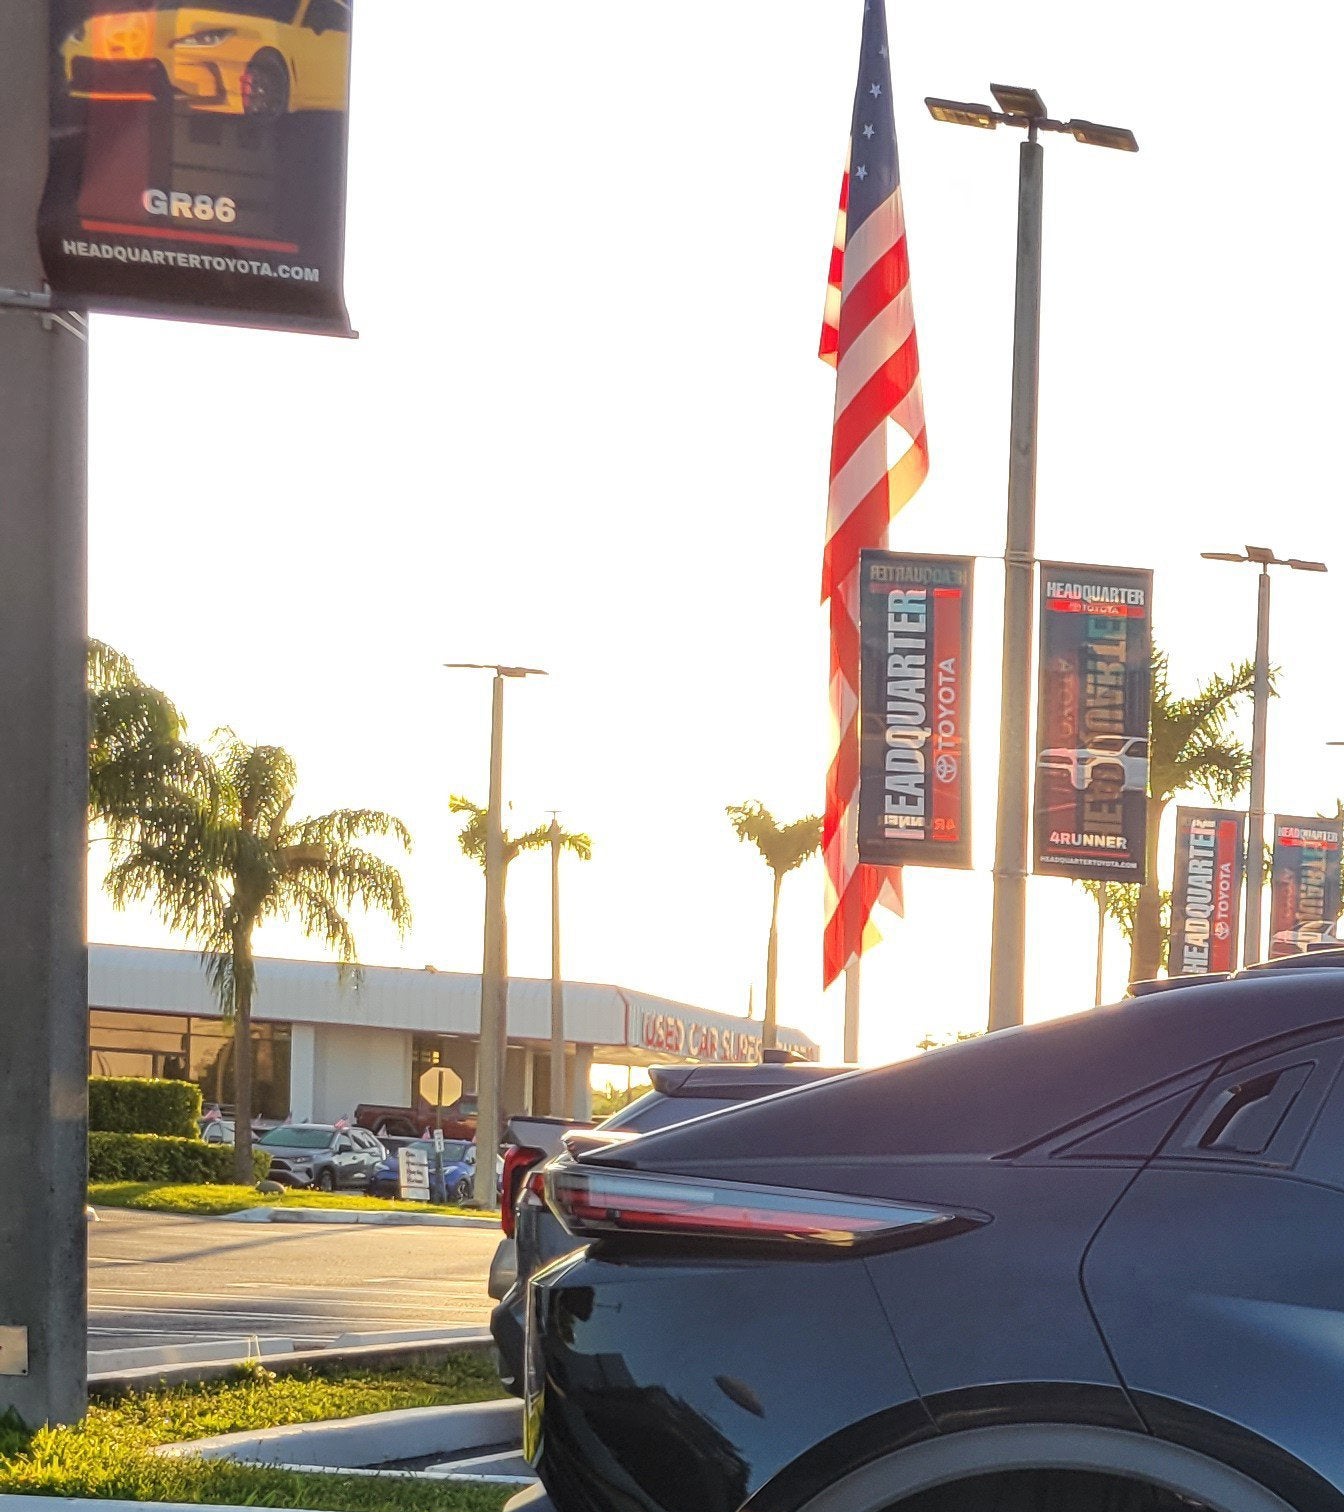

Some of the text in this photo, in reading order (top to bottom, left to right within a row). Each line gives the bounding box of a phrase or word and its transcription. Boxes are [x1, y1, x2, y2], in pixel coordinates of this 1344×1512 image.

[143, 189, 236, 222] GR86
[62, 240, 319, 282] HEADQUARTERTOYOTA.COM
[1046, 581, 1145, 606] HEADQUARTER
[1083, 603, 1119, 614] TOYOTA
[884, 588, 931, 839] HEADQUARTER
[937, 657, 956, 749] TOYOTA
[1050, 831, 1128, 850] 4RUNNER
[1182, 819, 1217, 974] HEADQUARTER
[1218, 862, 1231, 918] TOYOTA
[642, 1010, 686, 1052] USED
[688, 1021, 719, 1061] CAR
